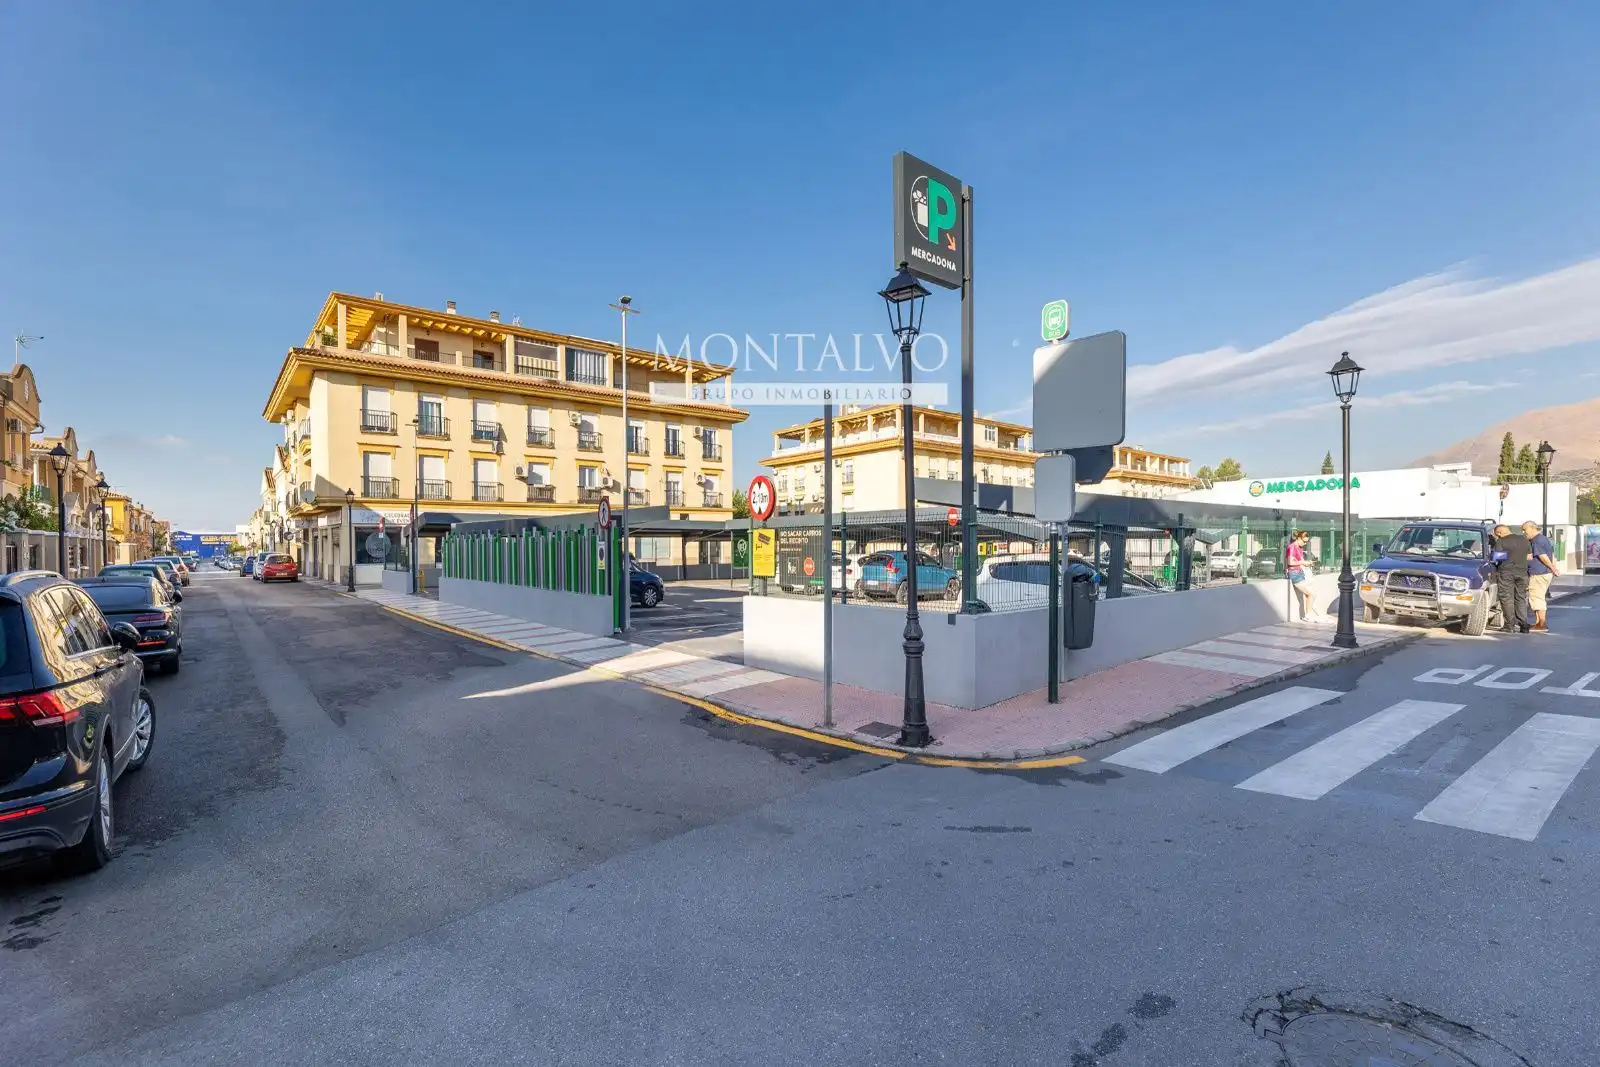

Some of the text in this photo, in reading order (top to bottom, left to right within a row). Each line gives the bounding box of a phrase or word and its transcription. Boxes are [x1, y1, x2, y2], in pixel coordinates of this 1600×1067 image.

[928, 178, 956, 244] P
[911, 246, 957, 271] MERCADONA
[1412, 664, 1600, 698] TOP
